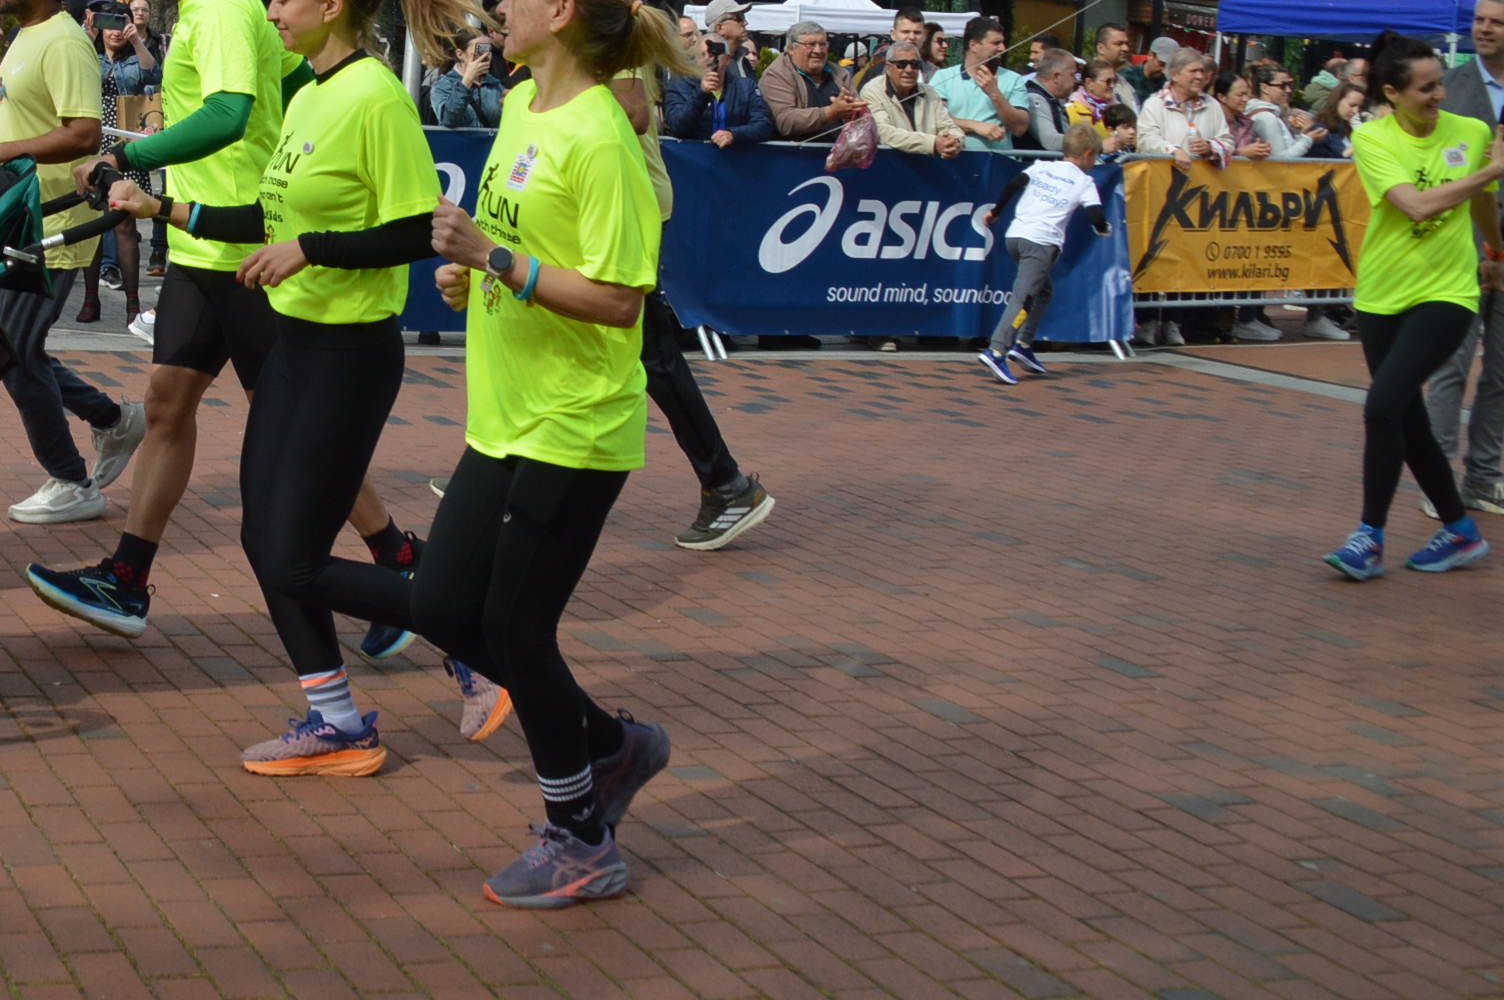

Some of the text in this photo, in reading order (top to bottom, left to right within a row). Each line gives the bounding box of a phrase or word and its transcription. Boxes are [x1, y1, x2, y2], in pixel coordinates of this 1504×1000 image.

[841, 199, 997, 261] asics
[1223, 245, 1251, 260] 0700
[1207, 263, 1289, 281] www.kilari.bg
[826, 282, 882, 303] sound
[883, 282, 928, 305] mind,
